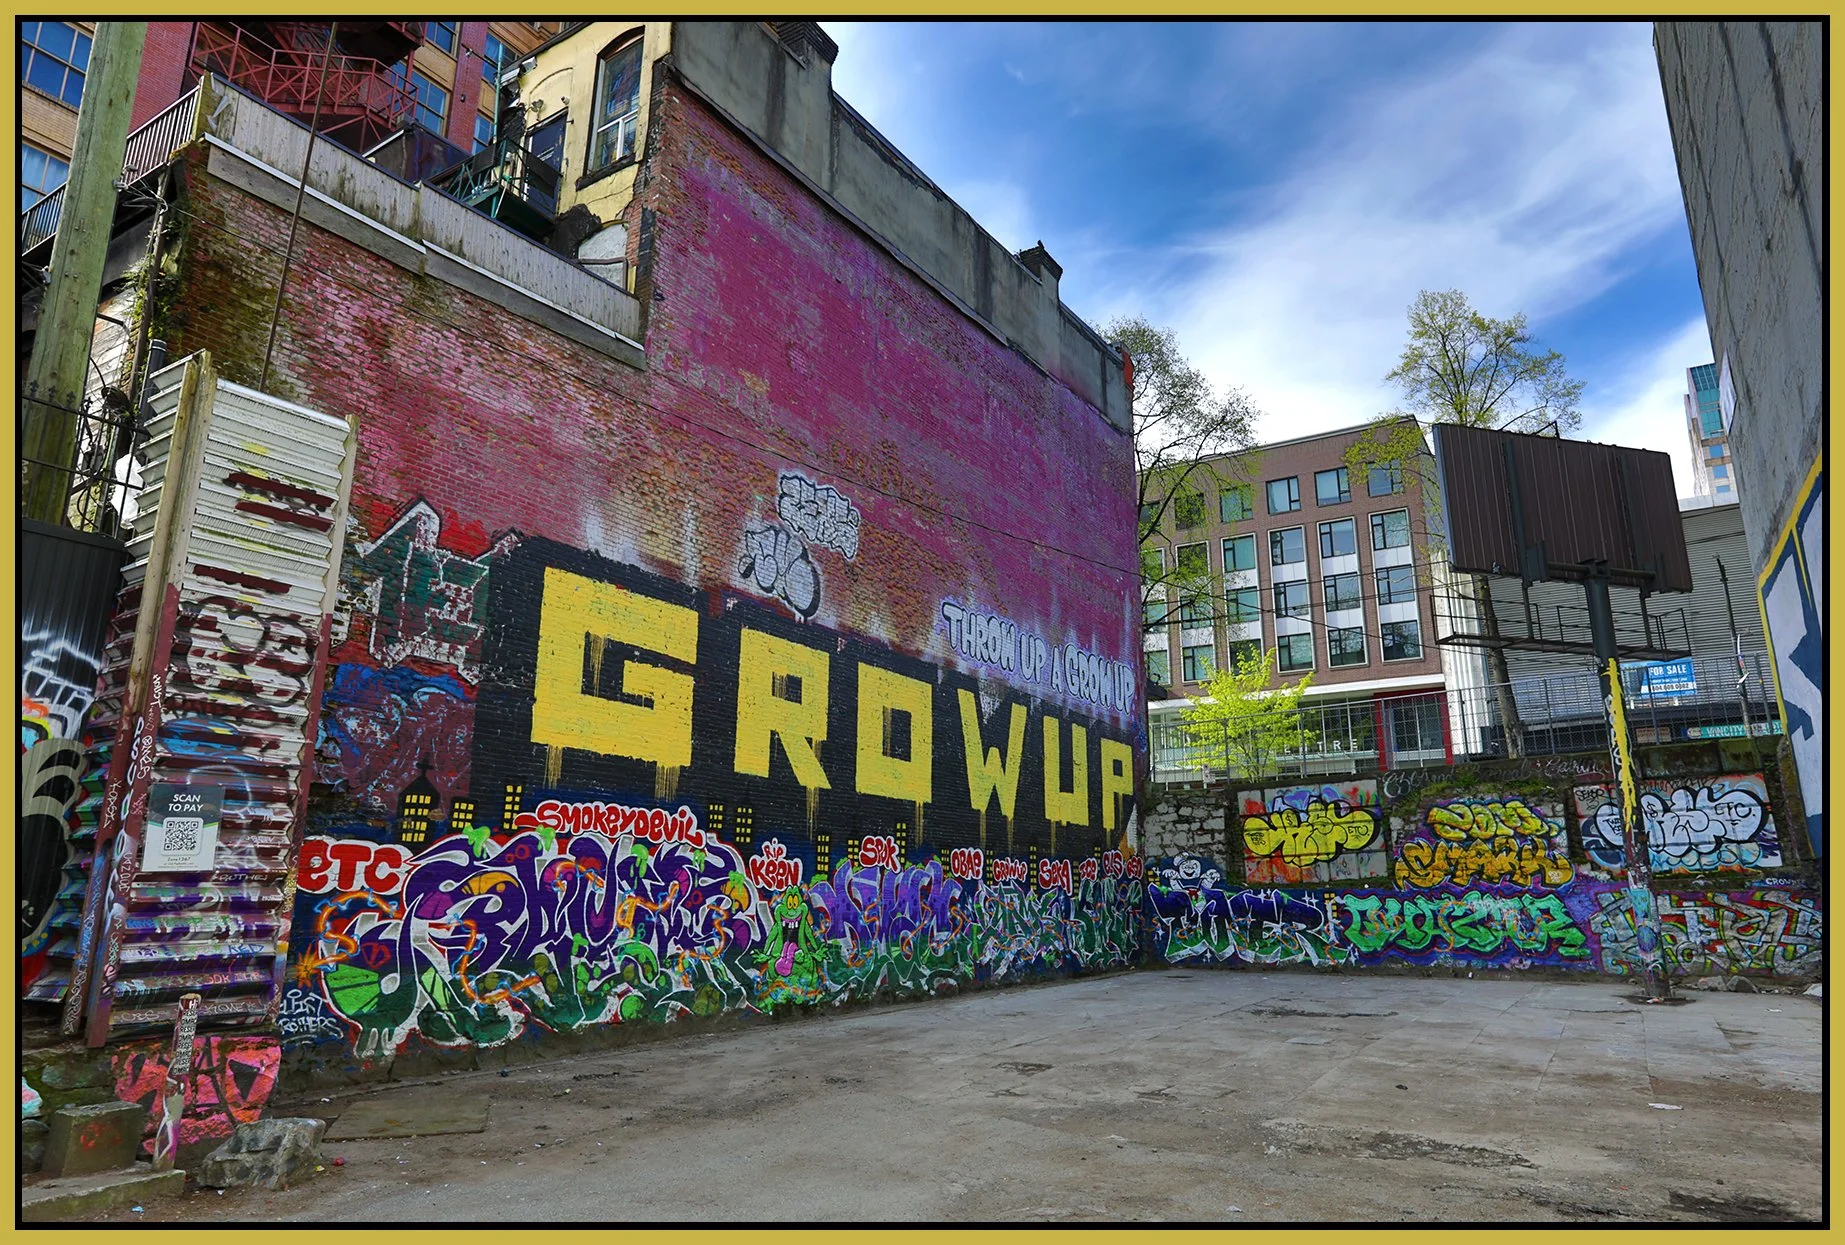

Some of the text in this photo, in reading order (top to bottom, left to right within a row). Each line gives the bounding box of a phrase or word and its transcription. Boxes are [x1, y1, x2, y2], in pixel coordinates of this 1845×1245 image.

[942, 601, 1016, 672] THROW
[1020, 632, 1047, 684] UP
[1052, 645, 1063, 694] A
[1648, 664, 1687, 676] FOR SALE
[173, 794, 201, 802] SCAN
[168, 803, 204, 812] TO PAY
